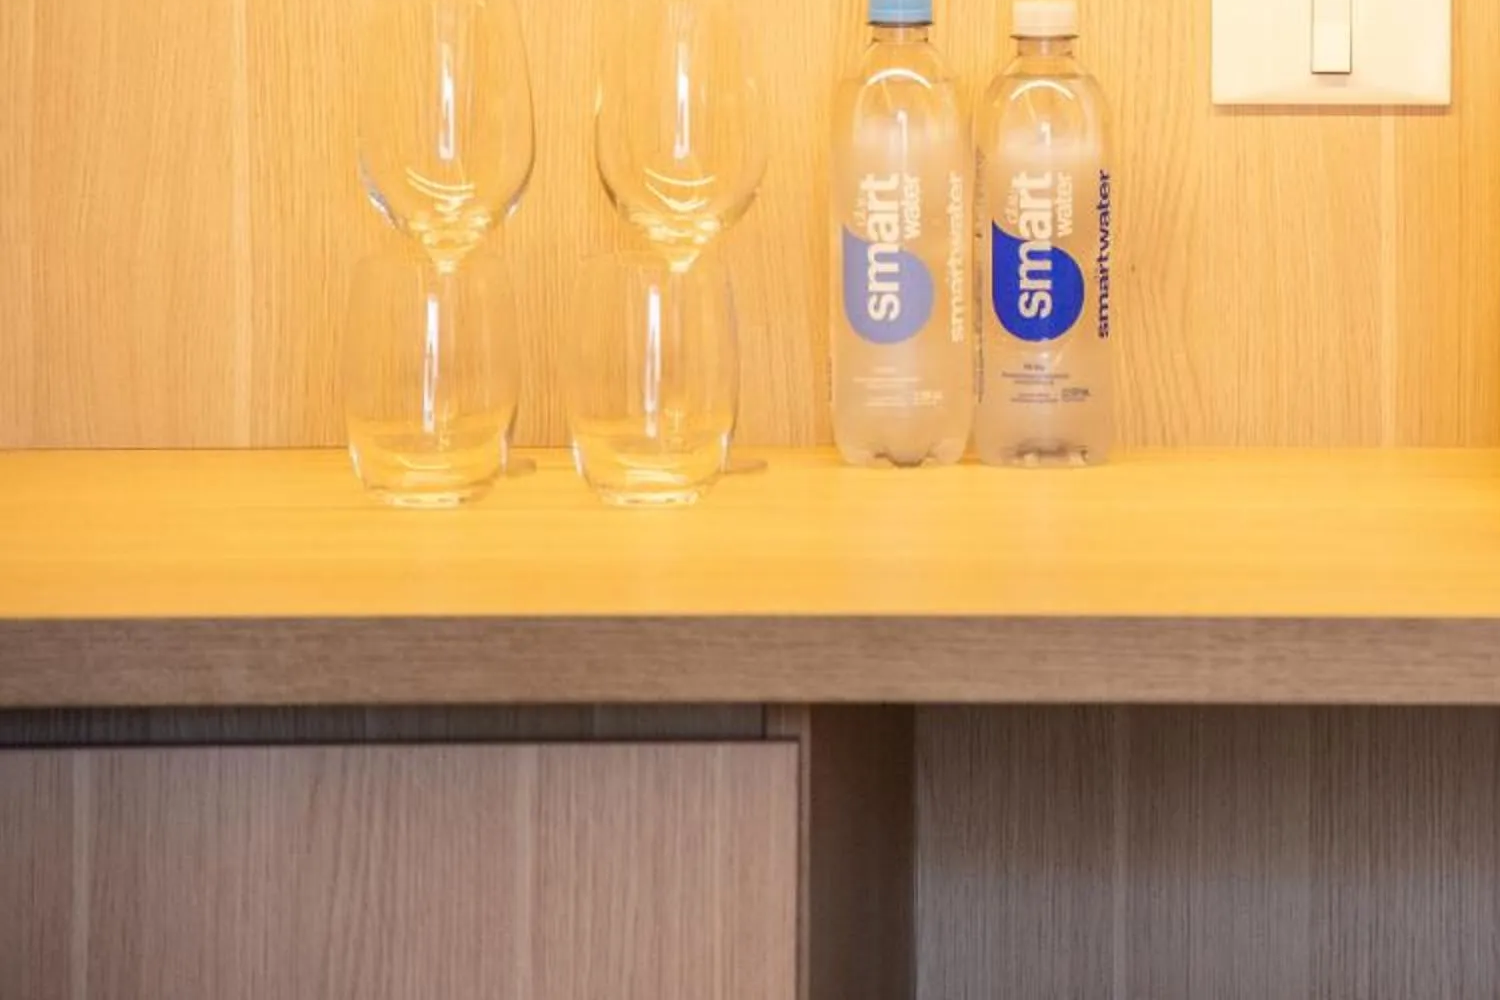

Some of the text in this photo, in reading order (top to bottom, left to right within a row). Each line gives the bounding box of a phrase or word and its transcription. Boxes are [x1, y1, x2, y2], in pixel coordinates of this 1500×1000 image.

[859, 172, 901, 322] smart
[901, 172, 922, 240] water
[1012, 170, 1053, 320] smart
[1056, 170, 1074, 238] water
[1097, 168, 1111, 339] smartwater
